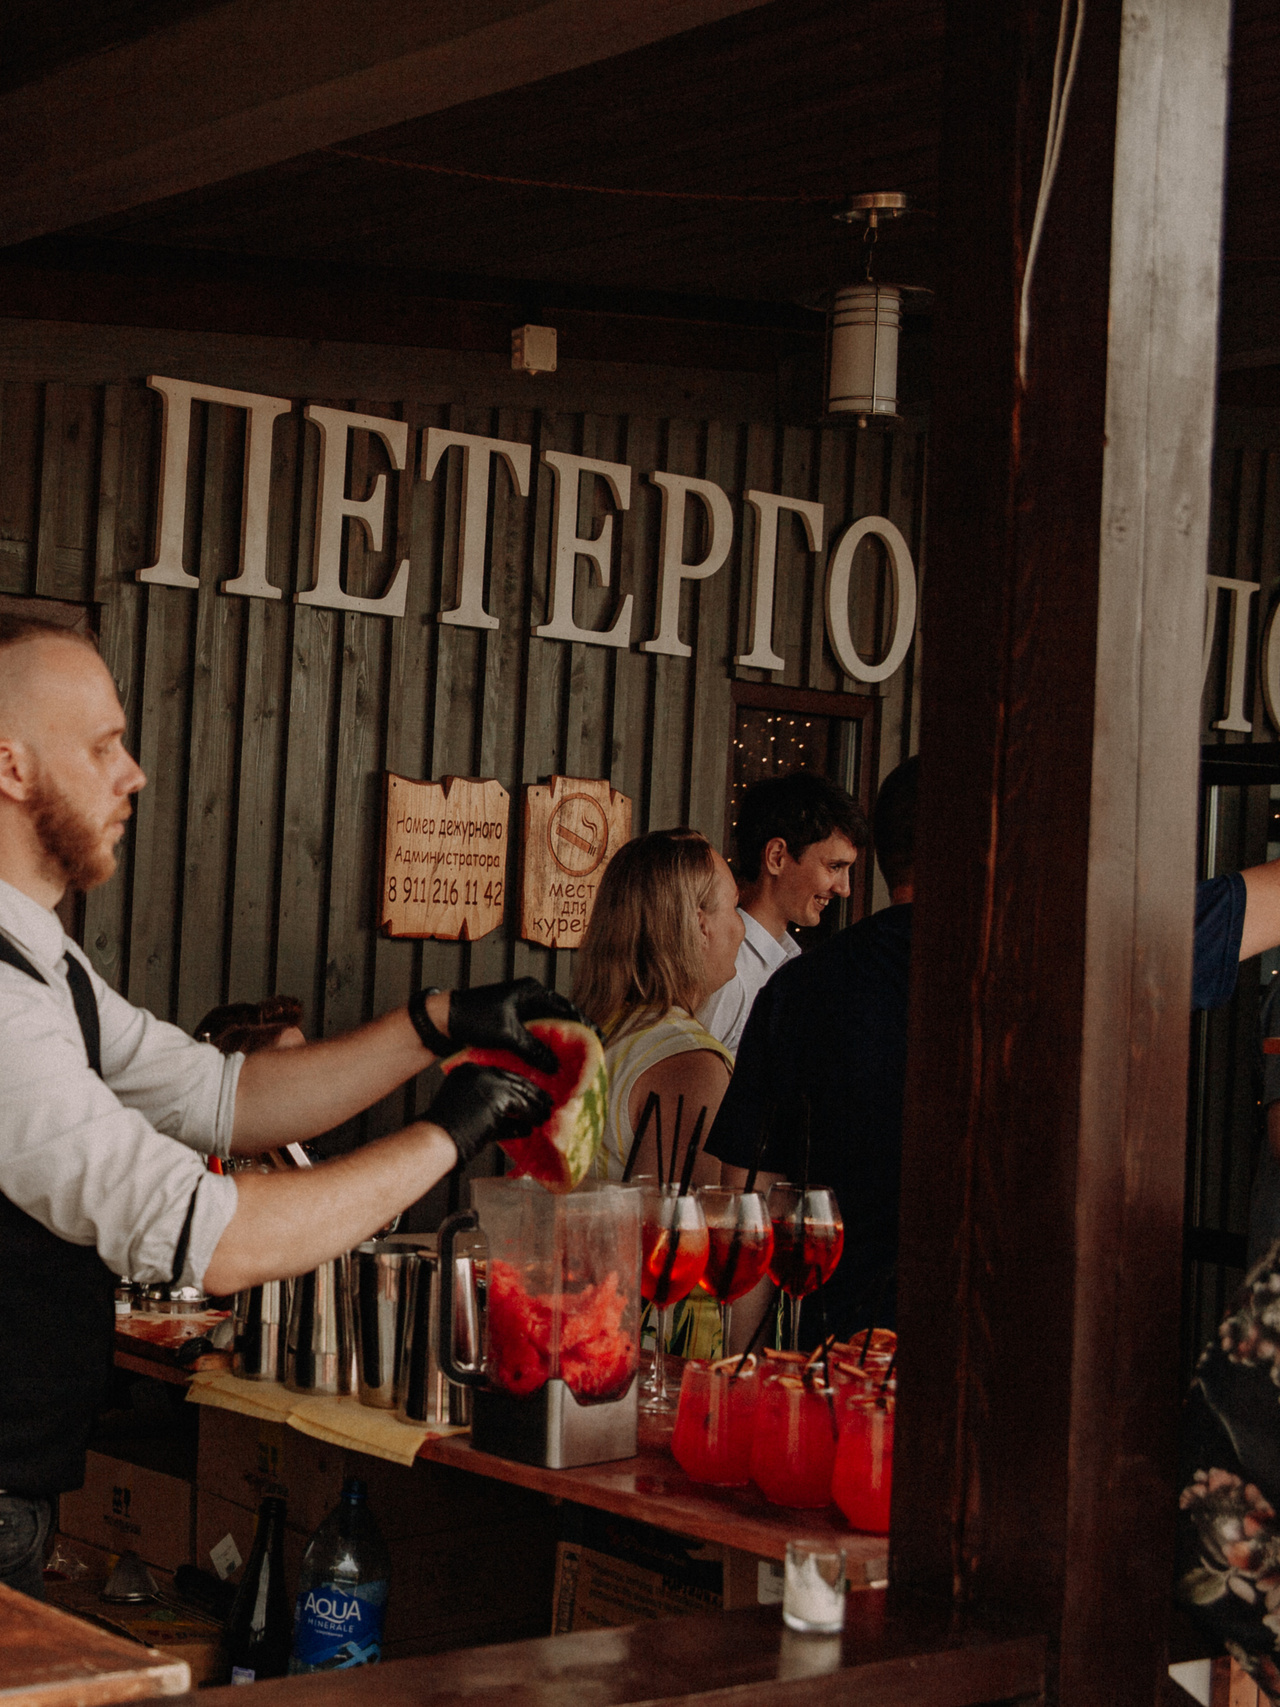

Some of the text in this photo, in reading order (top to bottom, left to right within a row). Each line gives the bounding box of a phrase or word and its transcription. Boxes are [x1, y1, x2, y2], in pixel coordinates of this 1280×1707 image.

[135, 375, 918, 684] ПЕТЕРГО
[396, 814, 502, 845] Номер дежурного
[394, 846, 500, 872] Администратора
[388, 876, 503, 907] 8 911 216 11 42
[548, 883, 595, 899] мест
[561, 901, 587, 917] для
[304, 1592, 362, 1624] AQUA
[307, 1617, 355, 1634] MINERALE
